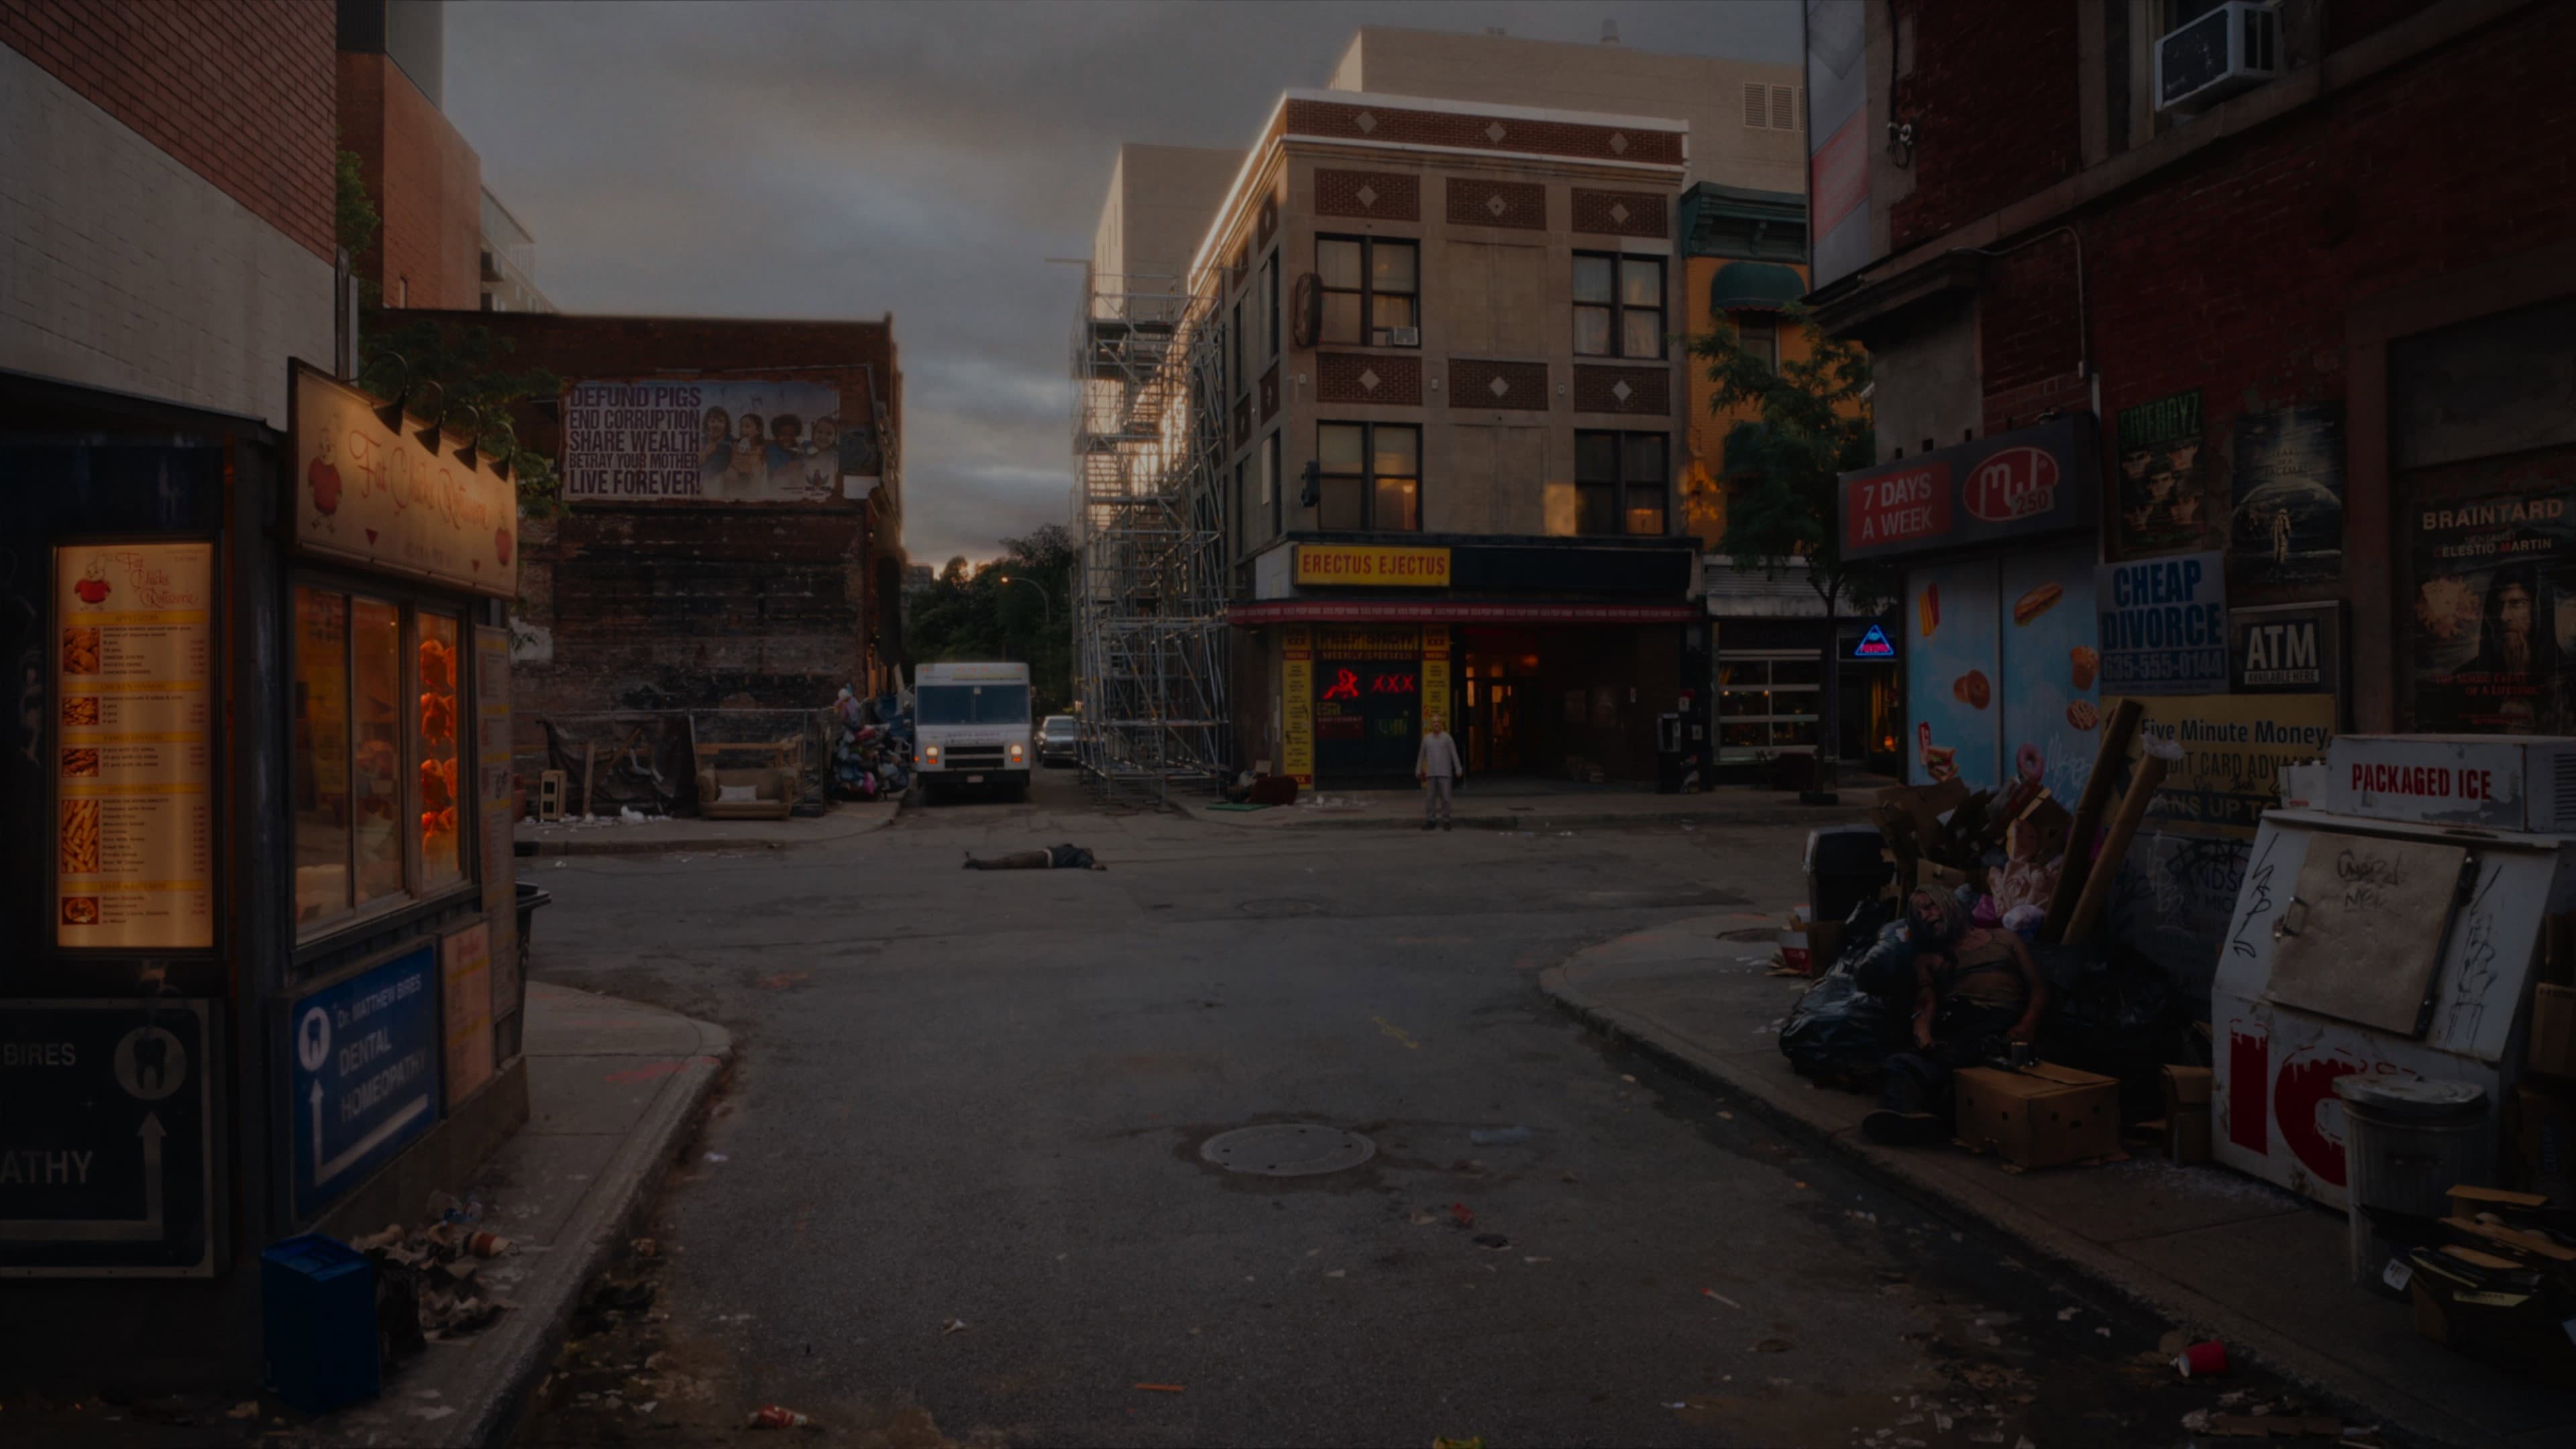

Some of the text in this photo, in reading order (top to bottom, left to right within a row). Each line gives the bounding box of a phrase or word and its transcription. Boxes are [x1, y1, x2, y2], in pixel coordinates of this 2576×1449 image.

[571, 386, 702, 407] DEFUND PIGS
[570, 410, 700, 429] END CORRUPTION
[570, 431, 700, 452] SHARE WEALTH
[570, 453, 698, 469] BETRAY YOUR MOTHER
[570, 470, 701, 494] LIVE FOREVER!
[1863, 472, 1933, 511] 7 DAYS
[2017, 490, 2048, 515] 250
[2422, 498, 2565, 531] BRAINTARD
[1862, 504, 1933, 540] A WEEK
[2434, 537, 2553, 559] CELESTIO MARTIN
[1303, 554, 1445, 576] ERECTUS EJECTUS
[2114, 559, 2201, 607] CHEAP
[2102, 602, 2222, 651] DIVORCE
[2247, 622, 2318, 670] ATM
[2103, 651, 2222, 681] 635-555-0144
[2248, 670, 2316, 684] AVAILABLE HERE
[1372, 674, 1415, 694] XXX
[2141, 718, 2175, 739] Five
[2181, 719, 2248, 743] Minute
[2200, 752, 2241, 778] CARD
[2352, 763, 2451, 798] PACKAGED
[2458, 769, 2491, 800] ICE
[2210, 796, 2241, 821] UP
[352, 987, 396, 1022] MATTHEW
[396, 972, 423, 1001] BIRES
[3, 1042, 76, 1067] BIRES
[339, 1026, 392, 1077] DENTAL
[341, 1046, 429, 1124] HOMEOPATHY
